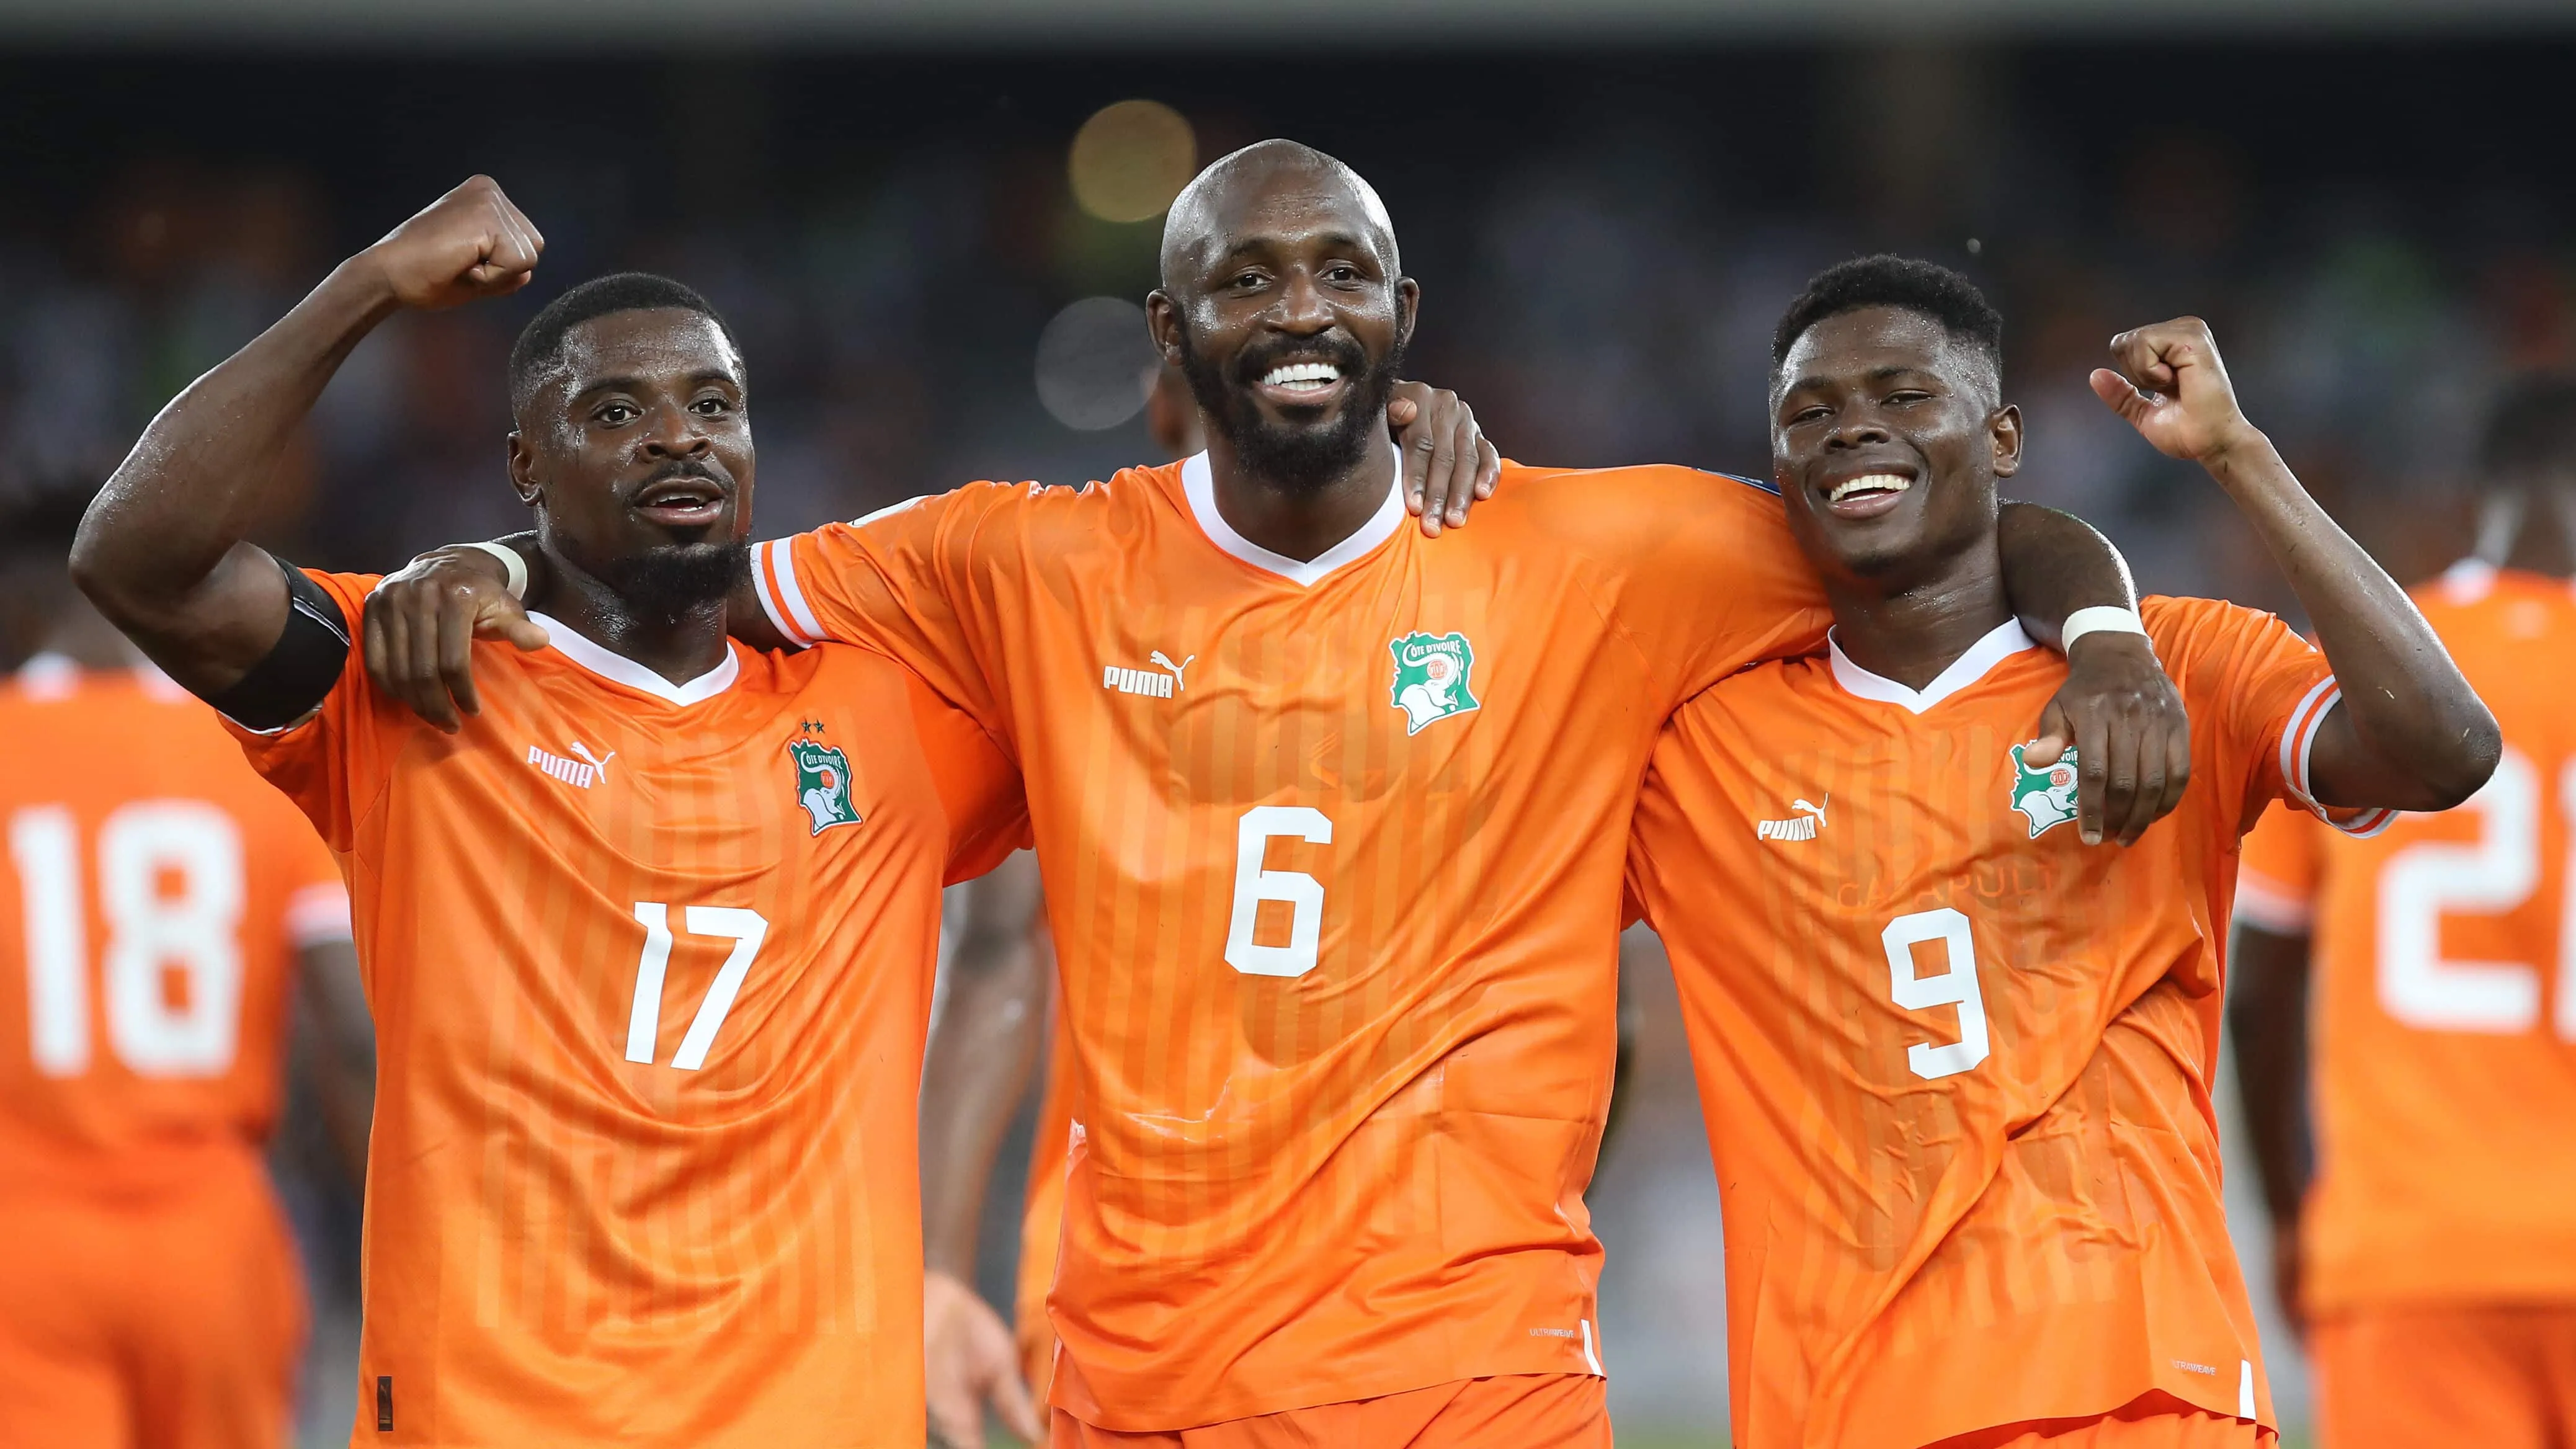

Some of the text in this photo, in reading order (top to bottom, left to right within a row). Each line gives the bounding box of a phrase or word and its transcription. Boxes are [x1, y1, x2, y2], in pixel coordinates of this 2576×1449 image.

[1103, 666, 1174, 698] PUMA
[1425, 640, 1463, 654] D'IVOIRE
[527, 745, 594, 789] PUMA
[1757, 815, 1817, 841] PUMA
[10, 801, 243, 1076] 18
[1224, 806, 1333, 978] 6
[625, 901, 770, 1071] 17
[1881, 907, 1990, 1080] 9
